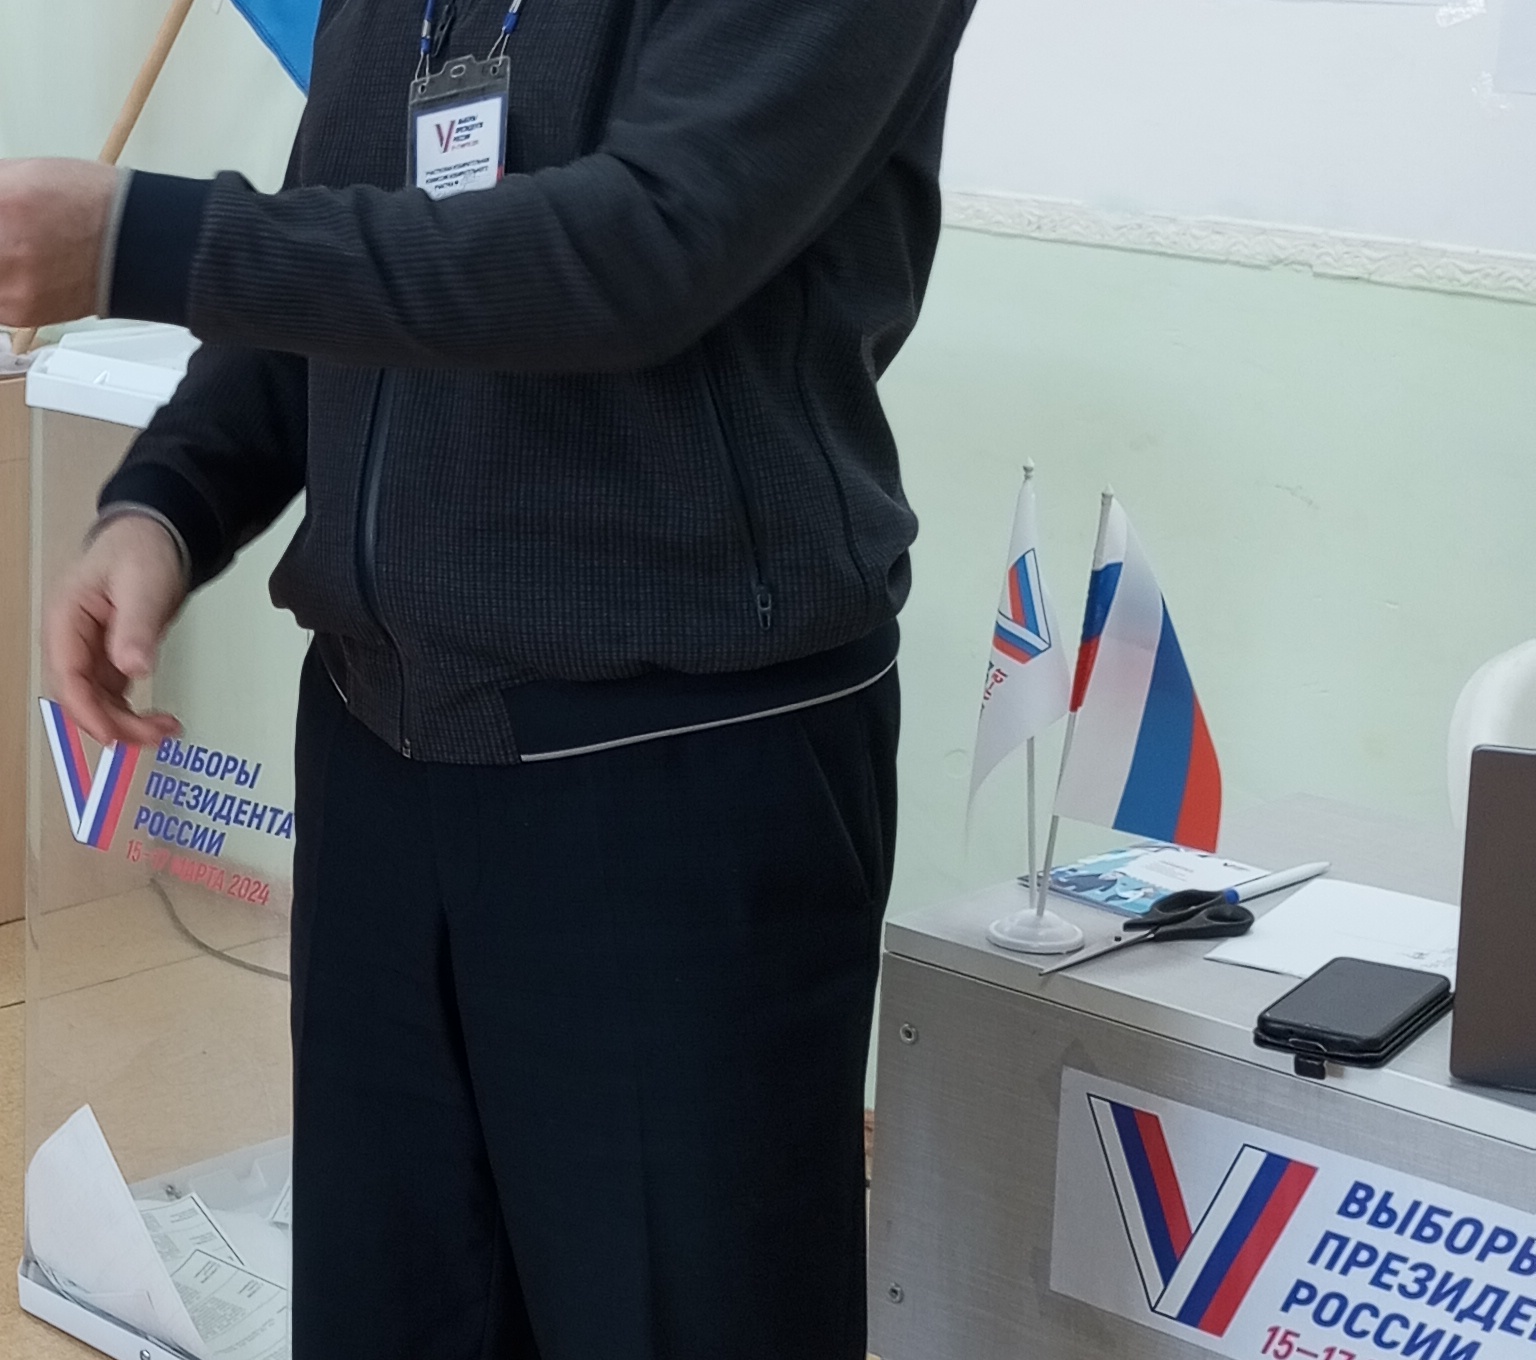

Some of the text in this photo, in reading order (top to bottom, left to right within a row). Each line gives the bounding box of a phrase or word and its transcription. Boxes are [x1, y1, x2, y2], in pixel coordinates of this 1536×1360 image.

[155, 737, 262, 789] ВЫБОРЫ
[145, 771, 296, 840] ПРЕЗИДЕНТА
[134, 806, 227, 858] РОССИИ
[227, 873, 270, 906] 2024
[1308, 1230, 1536, 1342] ПРЕЗИДЕ
